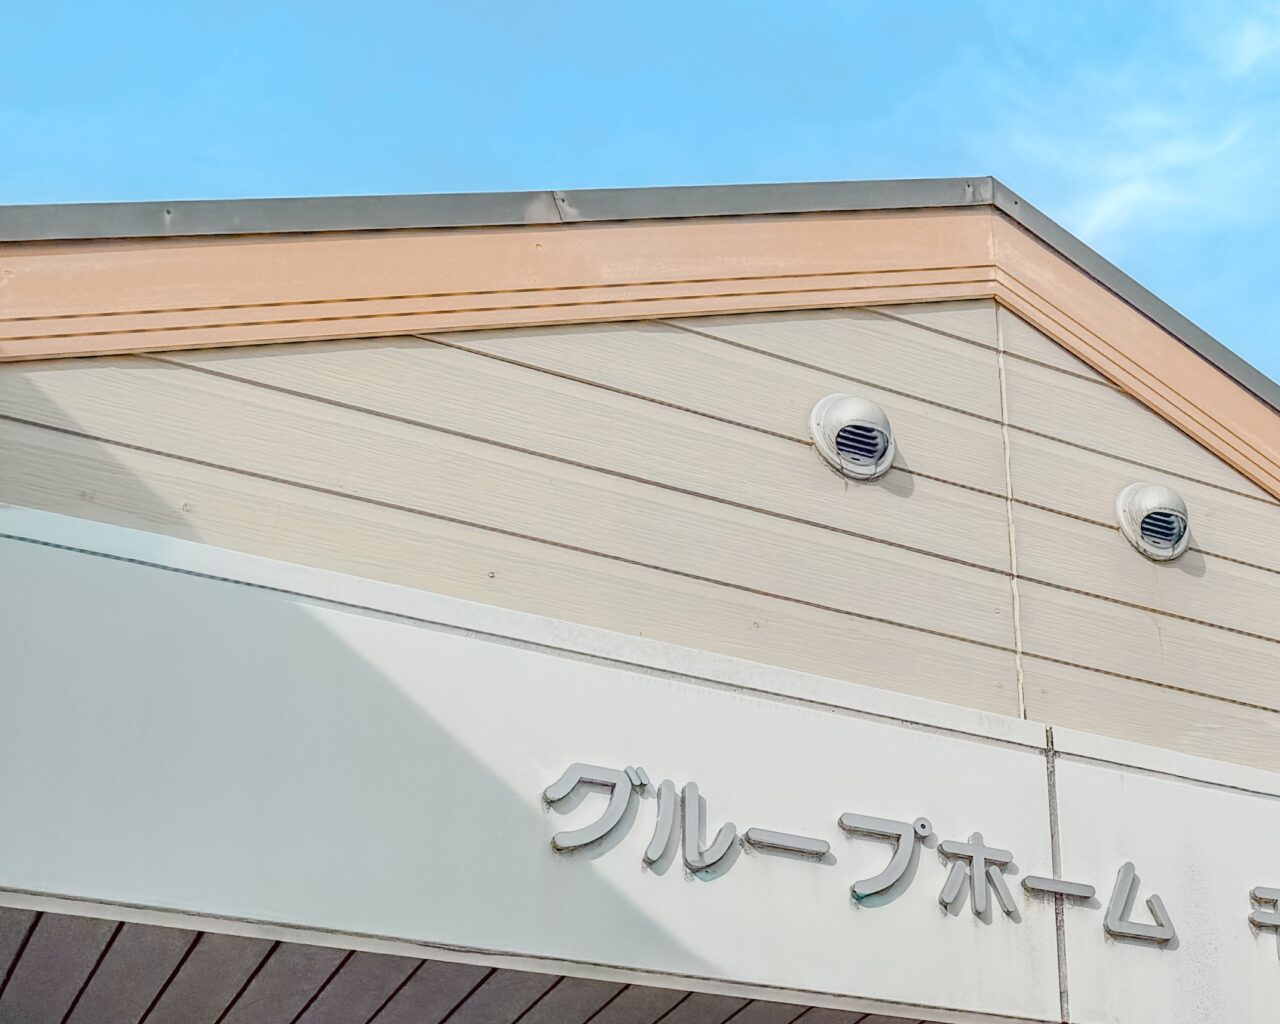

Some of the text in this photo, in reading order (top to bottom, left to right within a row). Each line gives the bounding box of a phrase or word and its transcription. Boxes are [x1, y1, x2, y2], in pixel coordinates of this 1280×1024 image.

[542, 762, 1175, 943] グループホーム
